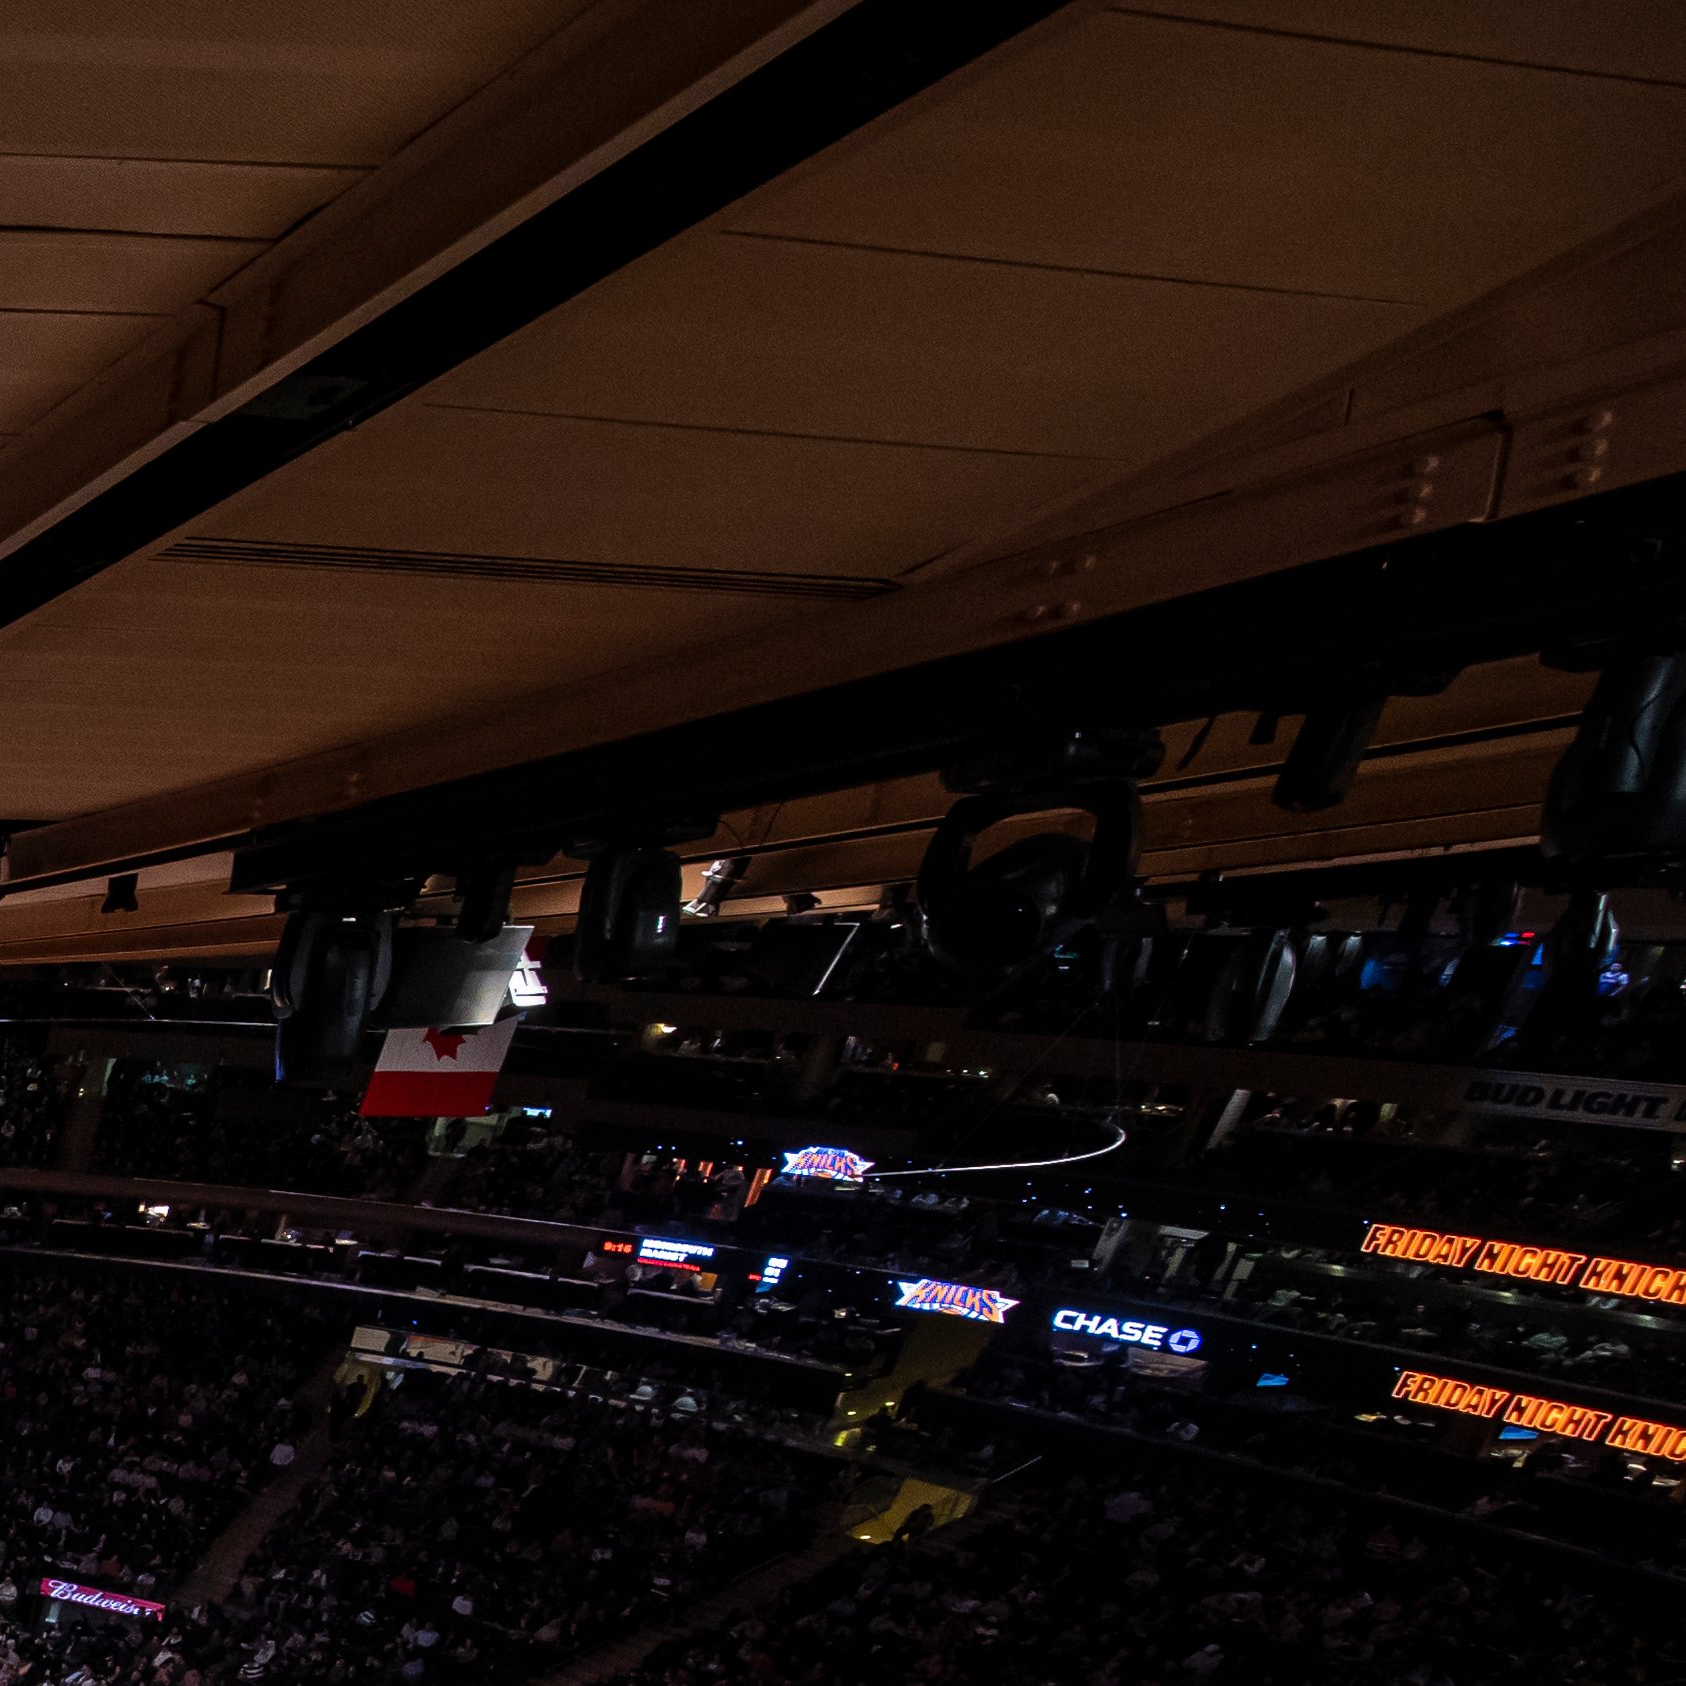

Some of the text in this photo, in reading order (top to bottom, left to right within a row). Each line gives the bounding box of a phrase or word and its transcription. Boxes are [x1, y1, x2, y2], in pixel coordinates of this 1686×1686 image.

[1464, 1081, 1545, 1107] BUD
[1547, 1088, 1669, 1119] LIGHT
[1360, 1222, 1481, 1270] FRIDAY
[1474, 1241, 1587, 1286] NIGHT
[908, 1279, 1007, 1323] KNICKS
[1053, 1308, 1167, 1349] CHASE
[1391, 1369, 1509, 1419] FRIDAY
[1501, 1393, 1614, 1442] NIGHT
